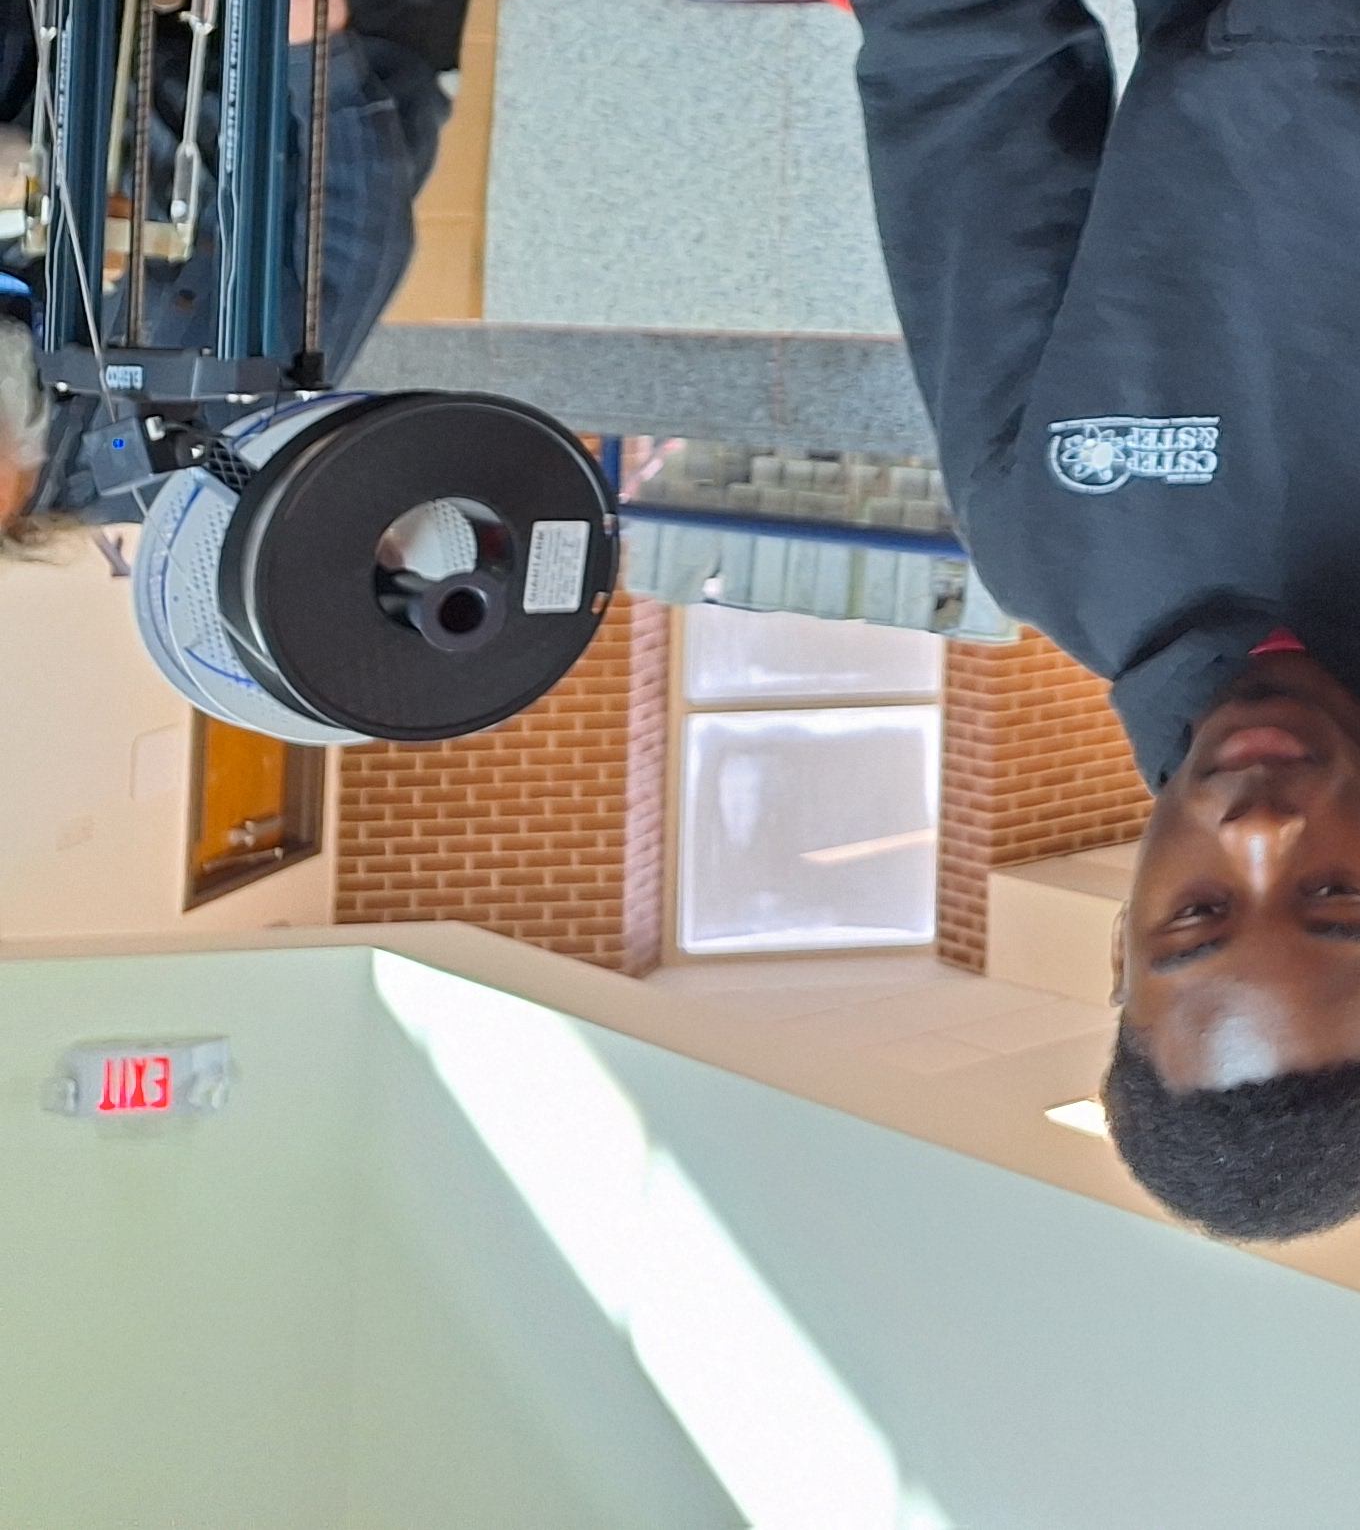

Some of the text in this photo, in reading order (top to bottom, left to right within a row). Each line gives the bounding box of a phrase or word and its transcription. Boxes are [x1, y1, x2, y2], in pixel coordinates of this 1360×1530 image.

[1125, 426, 1219, 450] &STEP
[1126, 450, 1218, 473] CSTEP
[98, 1056, 170, 1111] EXIT
